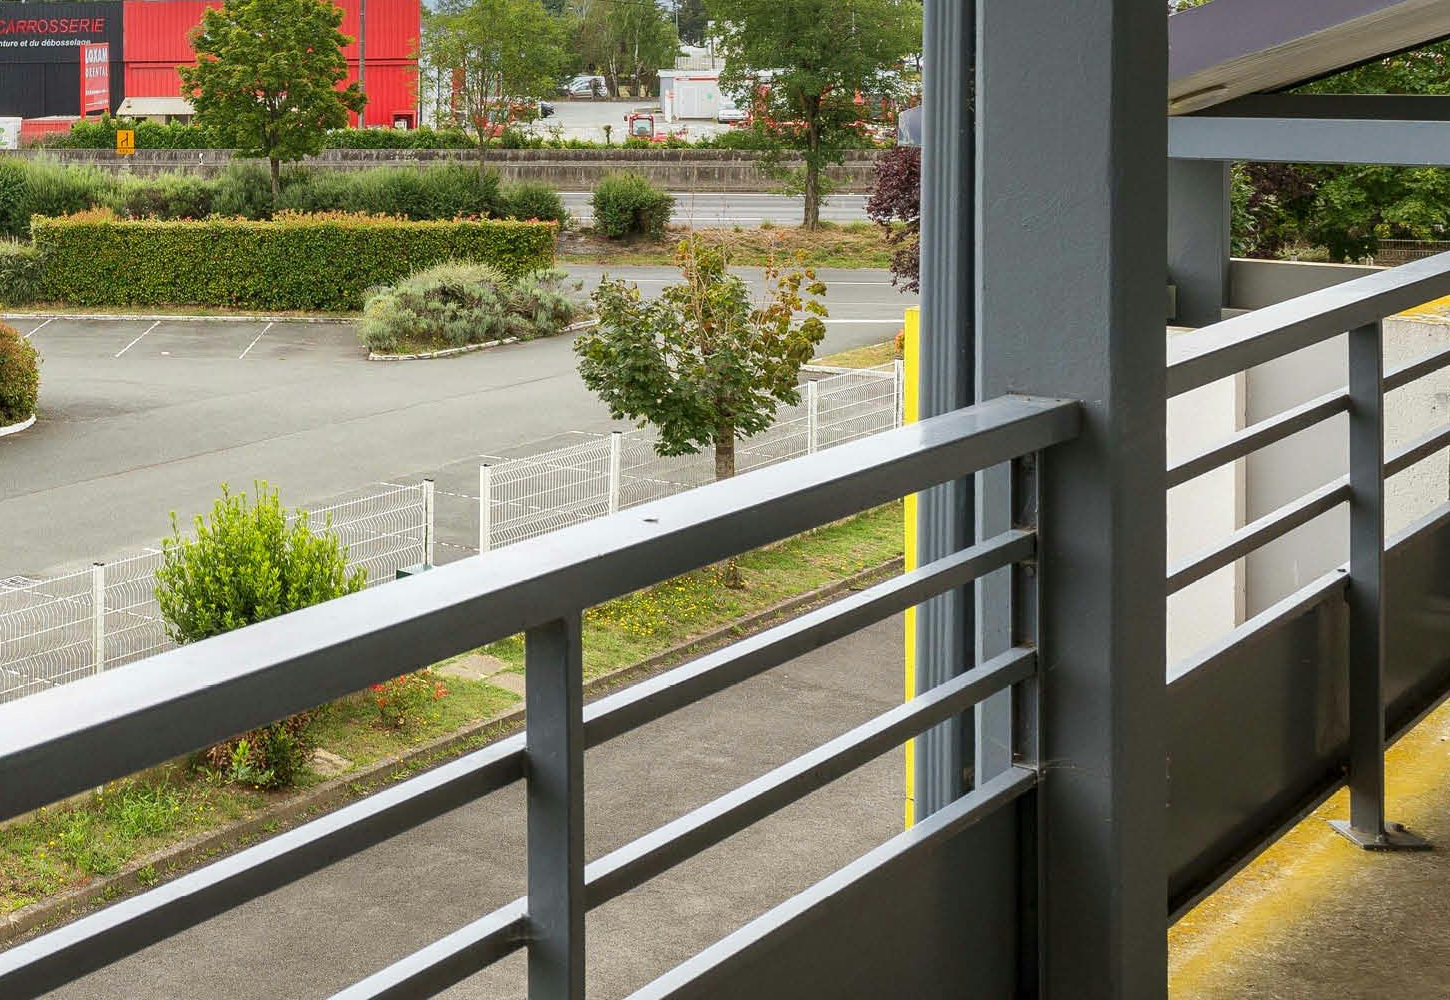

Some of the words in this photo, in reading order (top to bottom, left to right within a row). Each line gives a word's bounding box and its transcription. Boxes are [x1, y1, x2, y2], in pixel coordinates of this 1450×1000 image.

[20, 39, 28, 47] et
[29, 39, 39, 47] du
[85, 47, 109, 64] LOXAM
